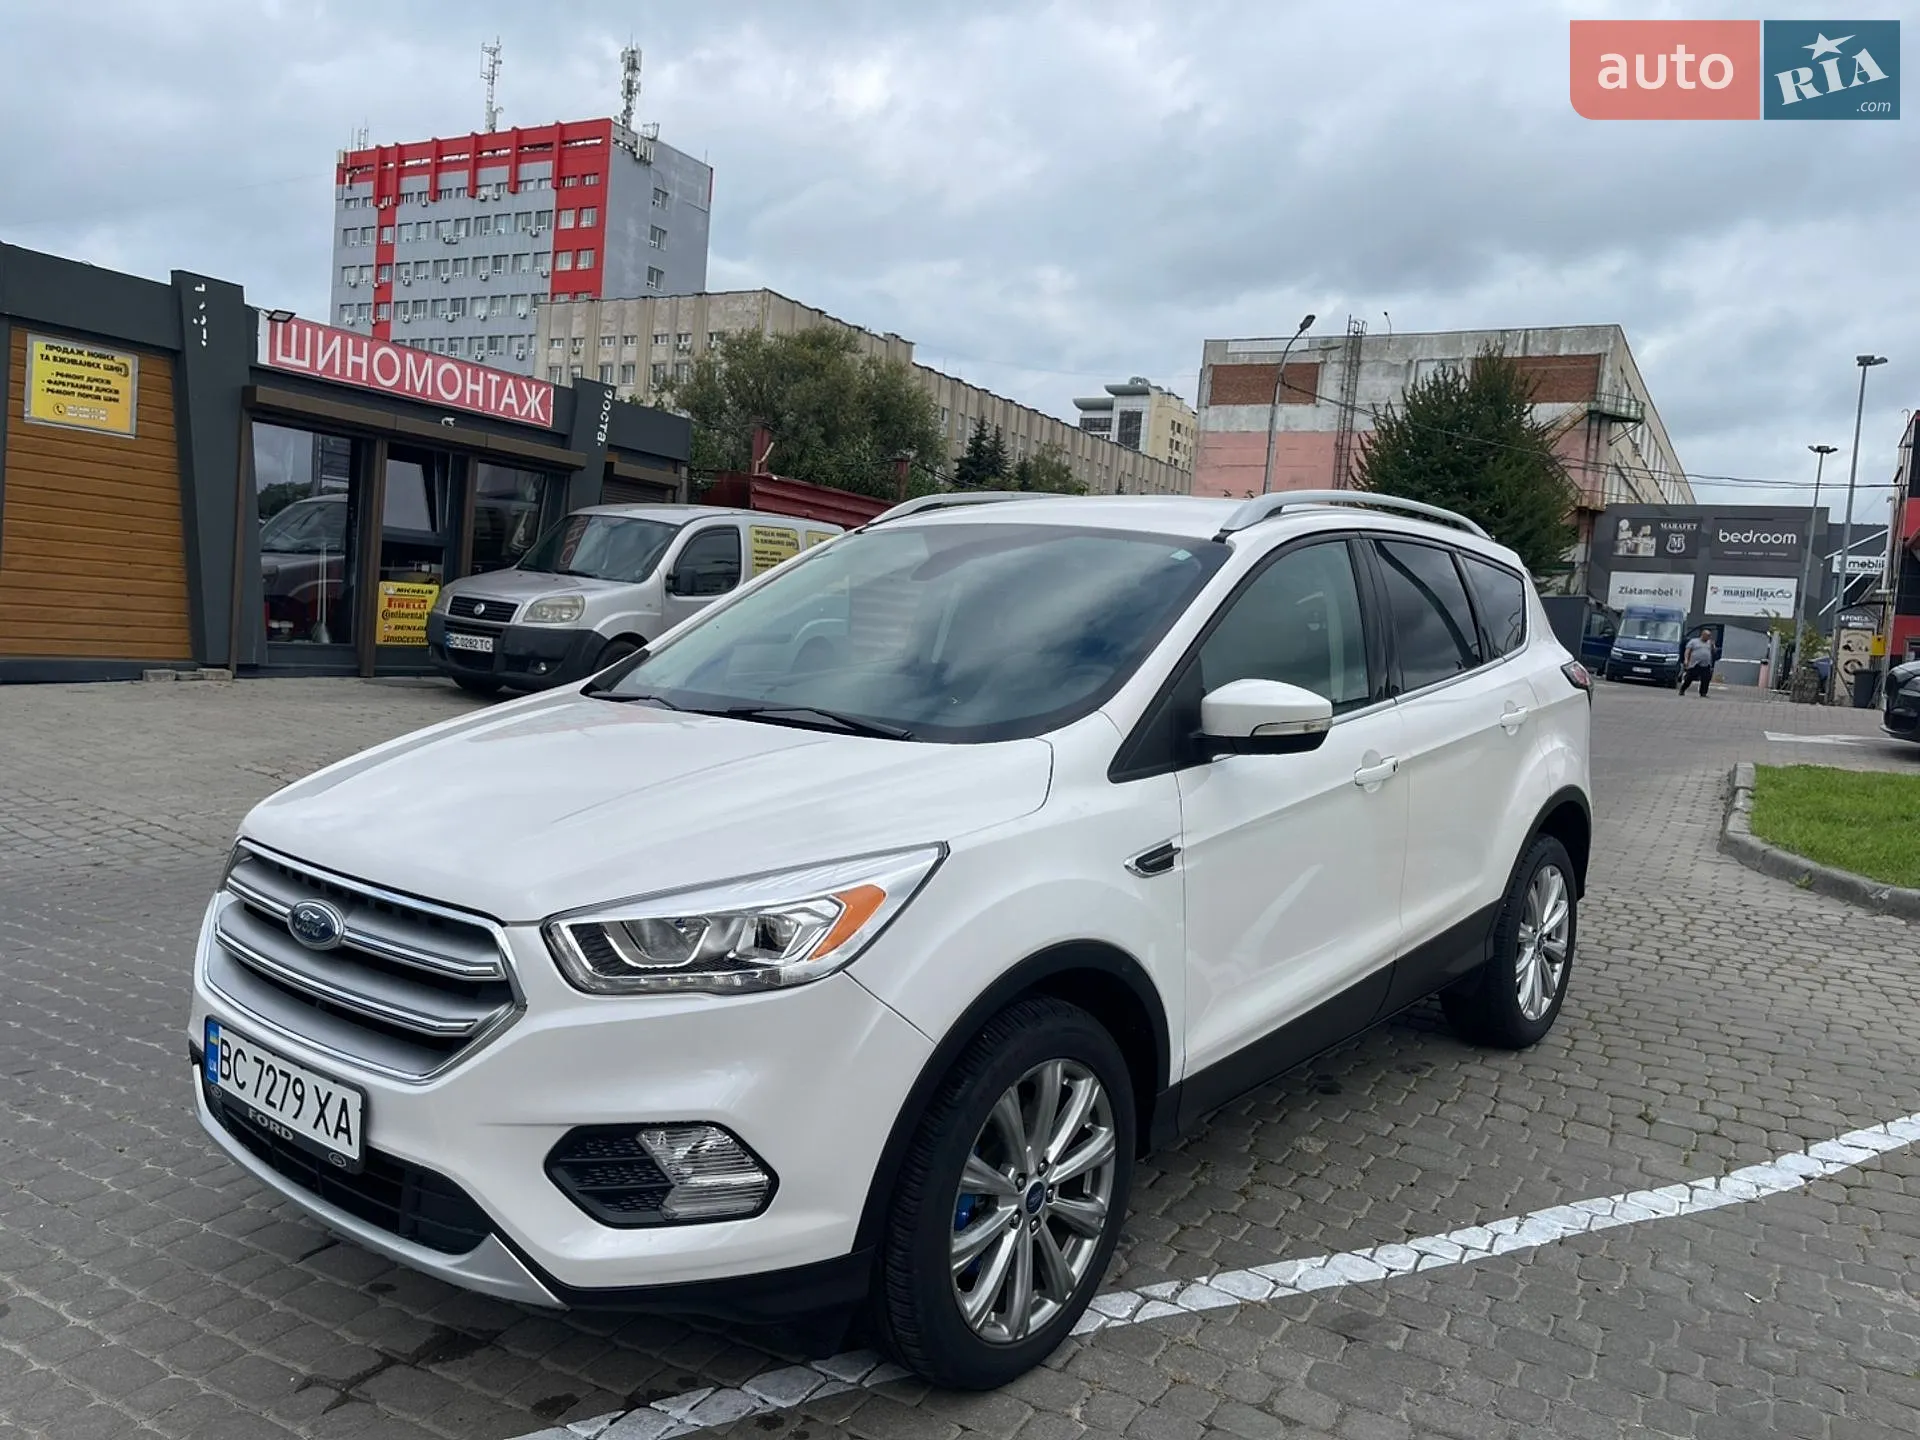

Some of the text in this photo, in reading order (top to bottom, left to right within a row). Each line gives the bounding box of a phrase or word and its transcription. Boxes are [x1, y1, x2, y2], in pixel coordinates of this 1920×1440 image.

[45, 343, 85, 356] ПРОДАЖ
[40, 353, 51, 362] ТА
[276, 322, 546, 421] ШИНОМОНТАЖ
[1719, 529, 1797, 544] bedroom
[396, 587, 434, 595] MICHELIN
[1618, 586, 1673, 597] Zlatamebel
[388, 597, 428, 609] PIRELLI
[381, 608, 426, 621] Continental
[220, 1037, 353, 1146] BC 7279 XA
[248, 1107, 294, 1141] FORD
